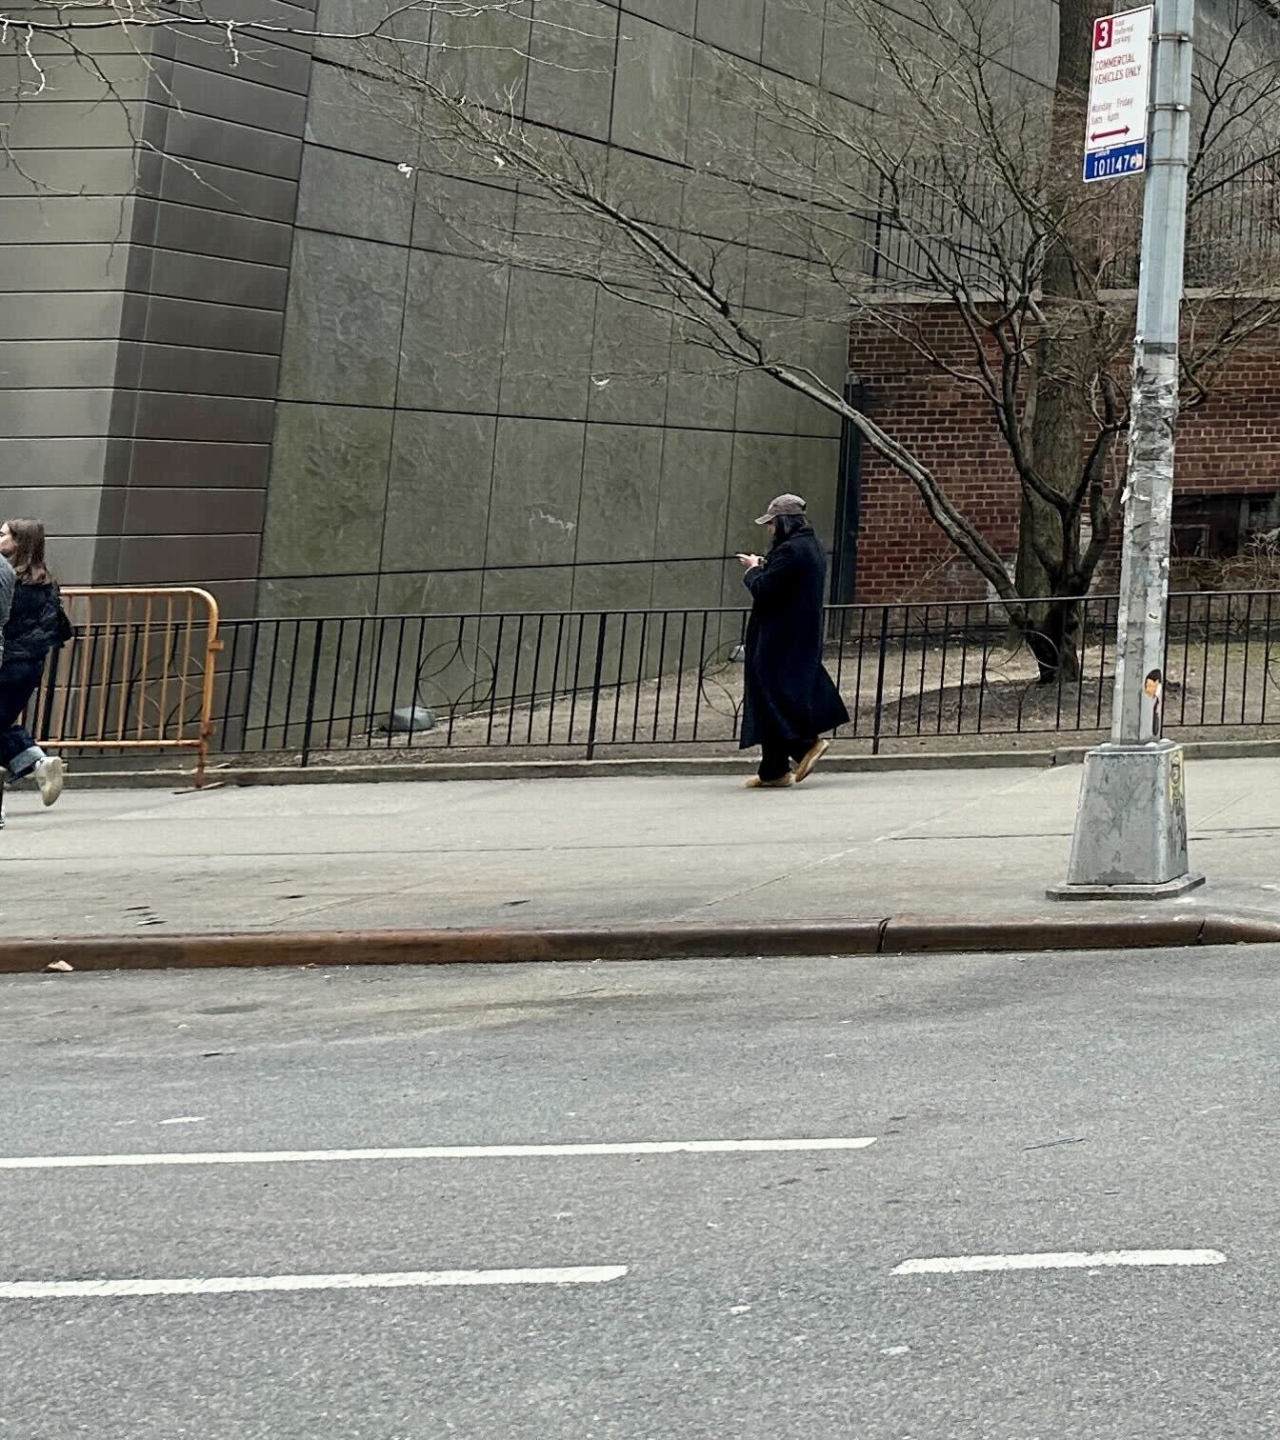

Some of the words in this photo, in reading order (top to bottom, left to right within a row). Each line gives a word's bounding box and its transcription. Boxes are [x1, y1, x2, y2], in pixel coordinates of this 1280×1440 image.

[1097, 20, 1109, 47] 3
[1094, 53, 1136, 71] COMMERCIAL
[1093, 69, 1124, 85] VEHICLES
[1125, 64, 1142, 78] ONLY
[1093, 154, 1130, 177] 101147
